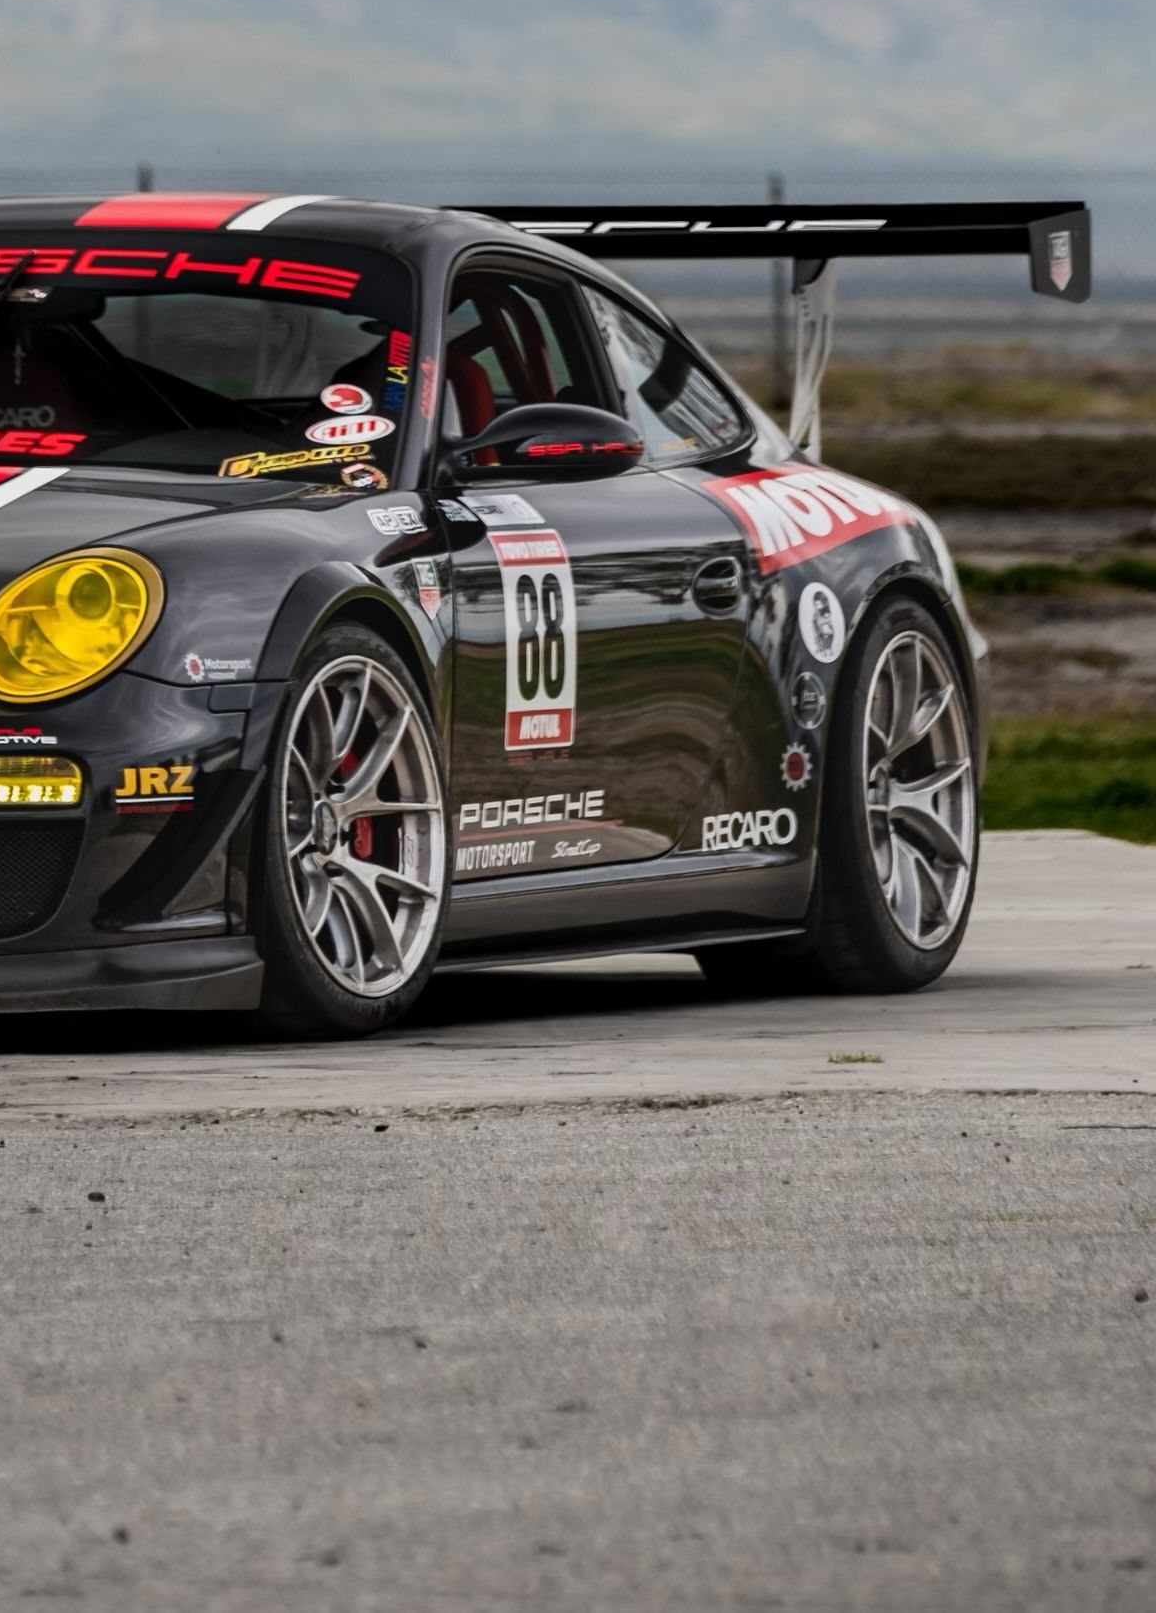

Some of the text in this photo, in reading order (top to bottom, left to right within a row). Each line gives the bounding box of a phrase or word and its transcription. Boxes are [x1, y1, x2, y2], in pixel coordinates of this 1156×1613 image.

[516, 572, 565, 701] 88
[519, 714, 561, 740] MOTUL
[115, 766, 194, 797] JRZ
[459, 789, 605, 831] PORSCHE
[701, 808, 799, 851] RECARO
[456, 840, 537, 871] MOTORSPORT
